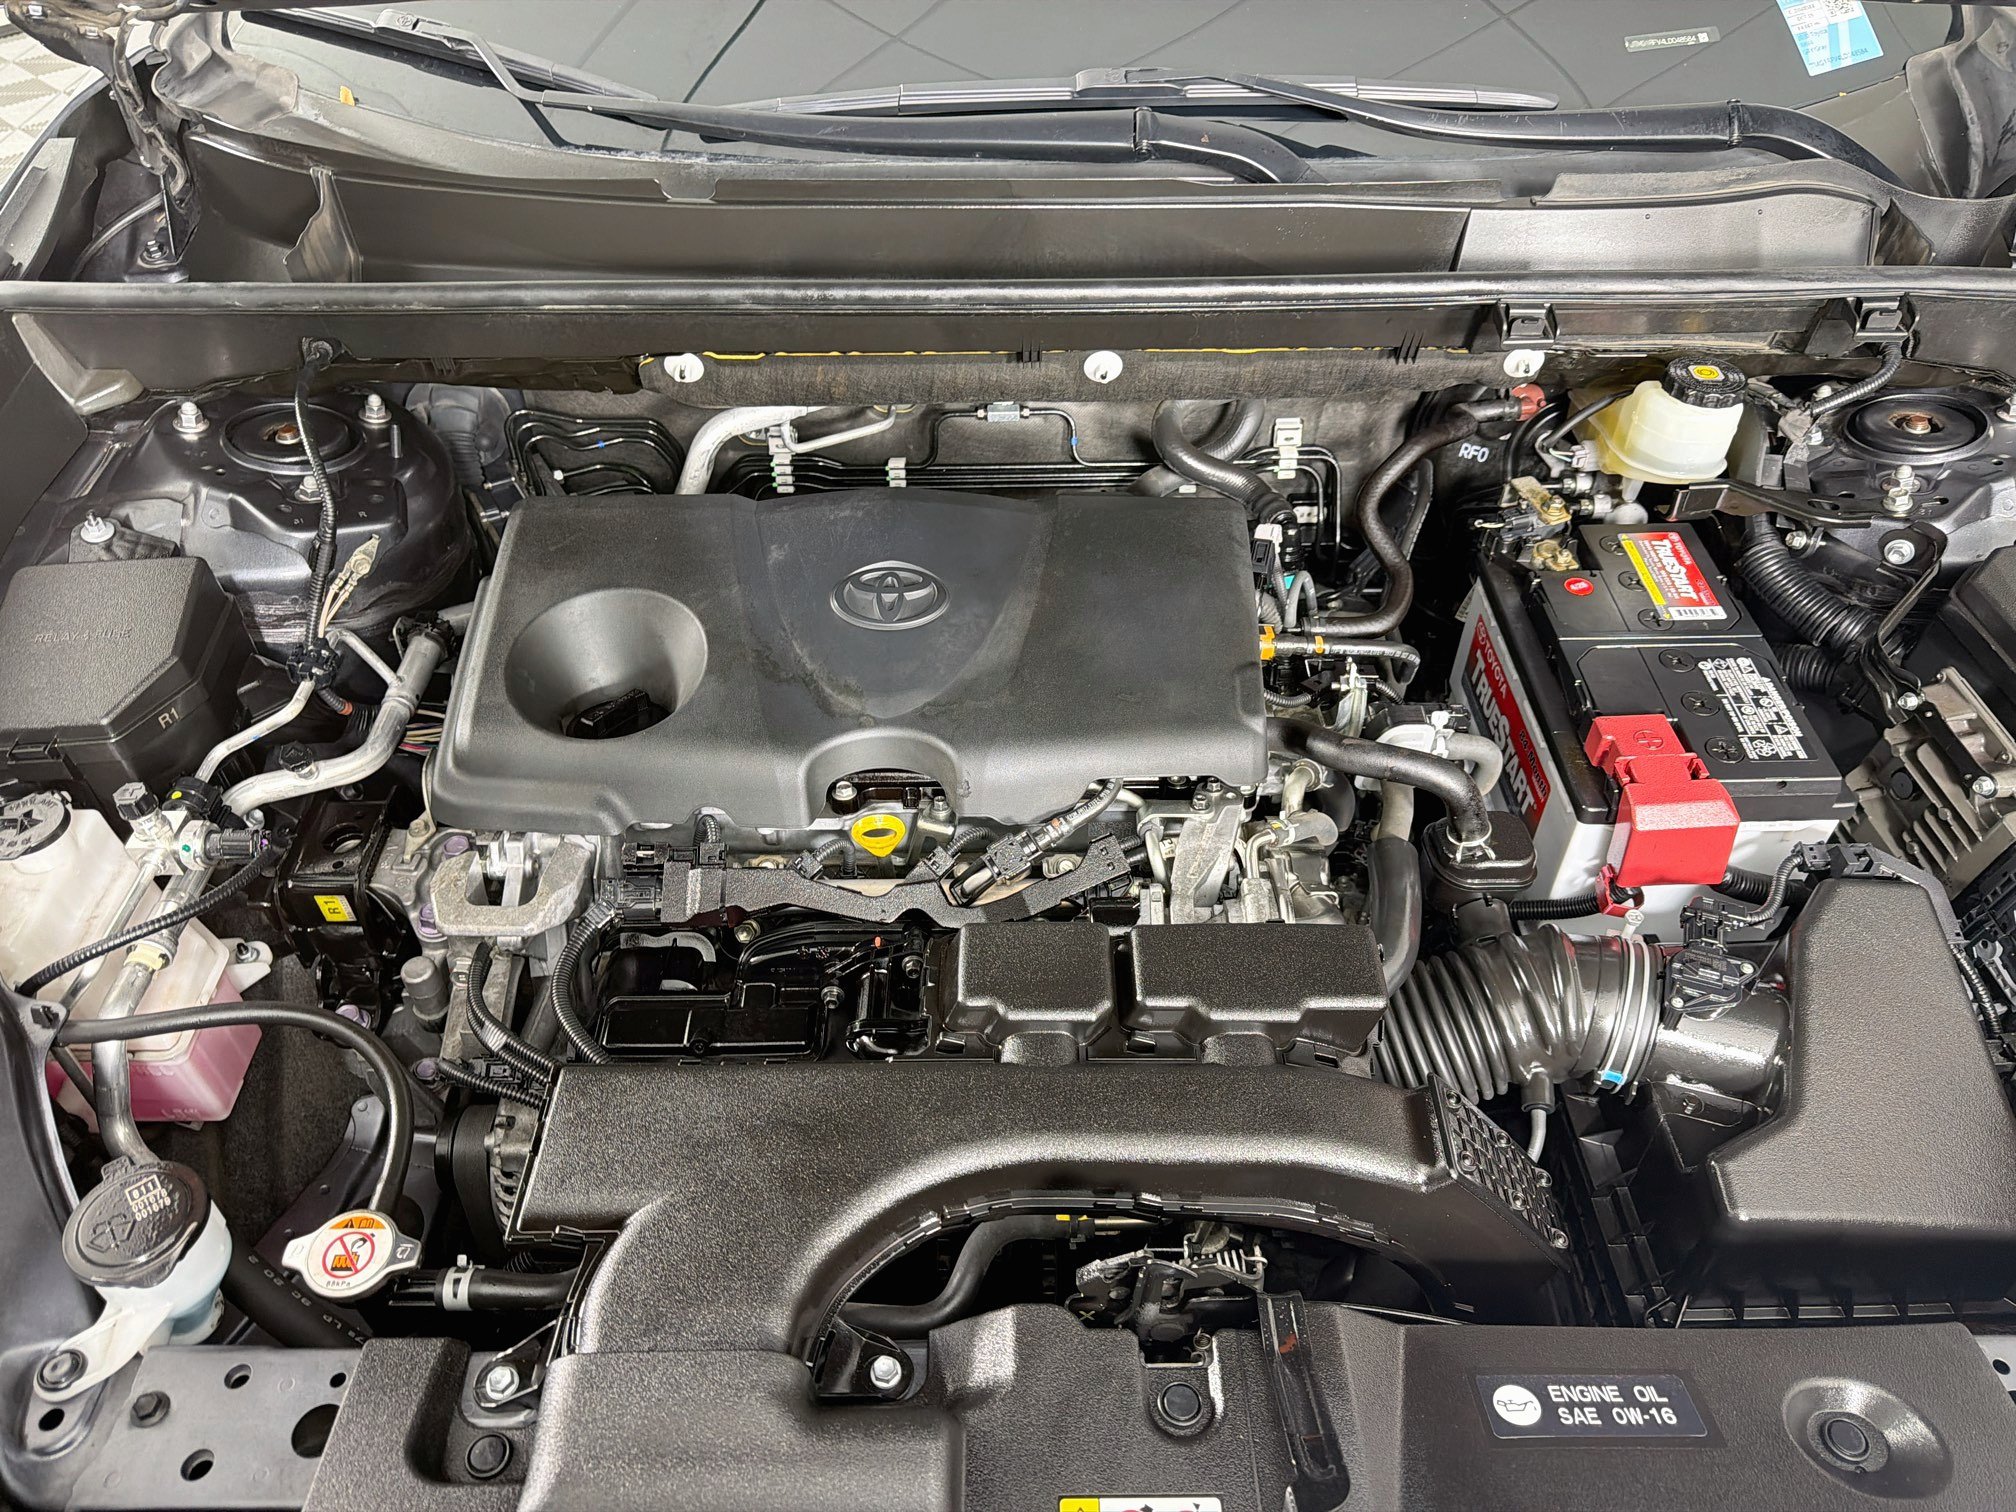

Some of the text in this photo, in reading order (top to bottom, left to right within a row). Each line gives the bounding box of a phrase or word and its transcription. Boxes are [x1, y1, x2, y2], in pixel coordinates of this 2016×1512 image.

[34, 631, 80, 643] RELAY
[1485, 639, 1507, 699] TOYOTA
[158, 707, 181, 729] R1
[1547, 1385, 1668, 1402] ENGINE OIL
[1558, 1407, 1602, 1425] SAE
